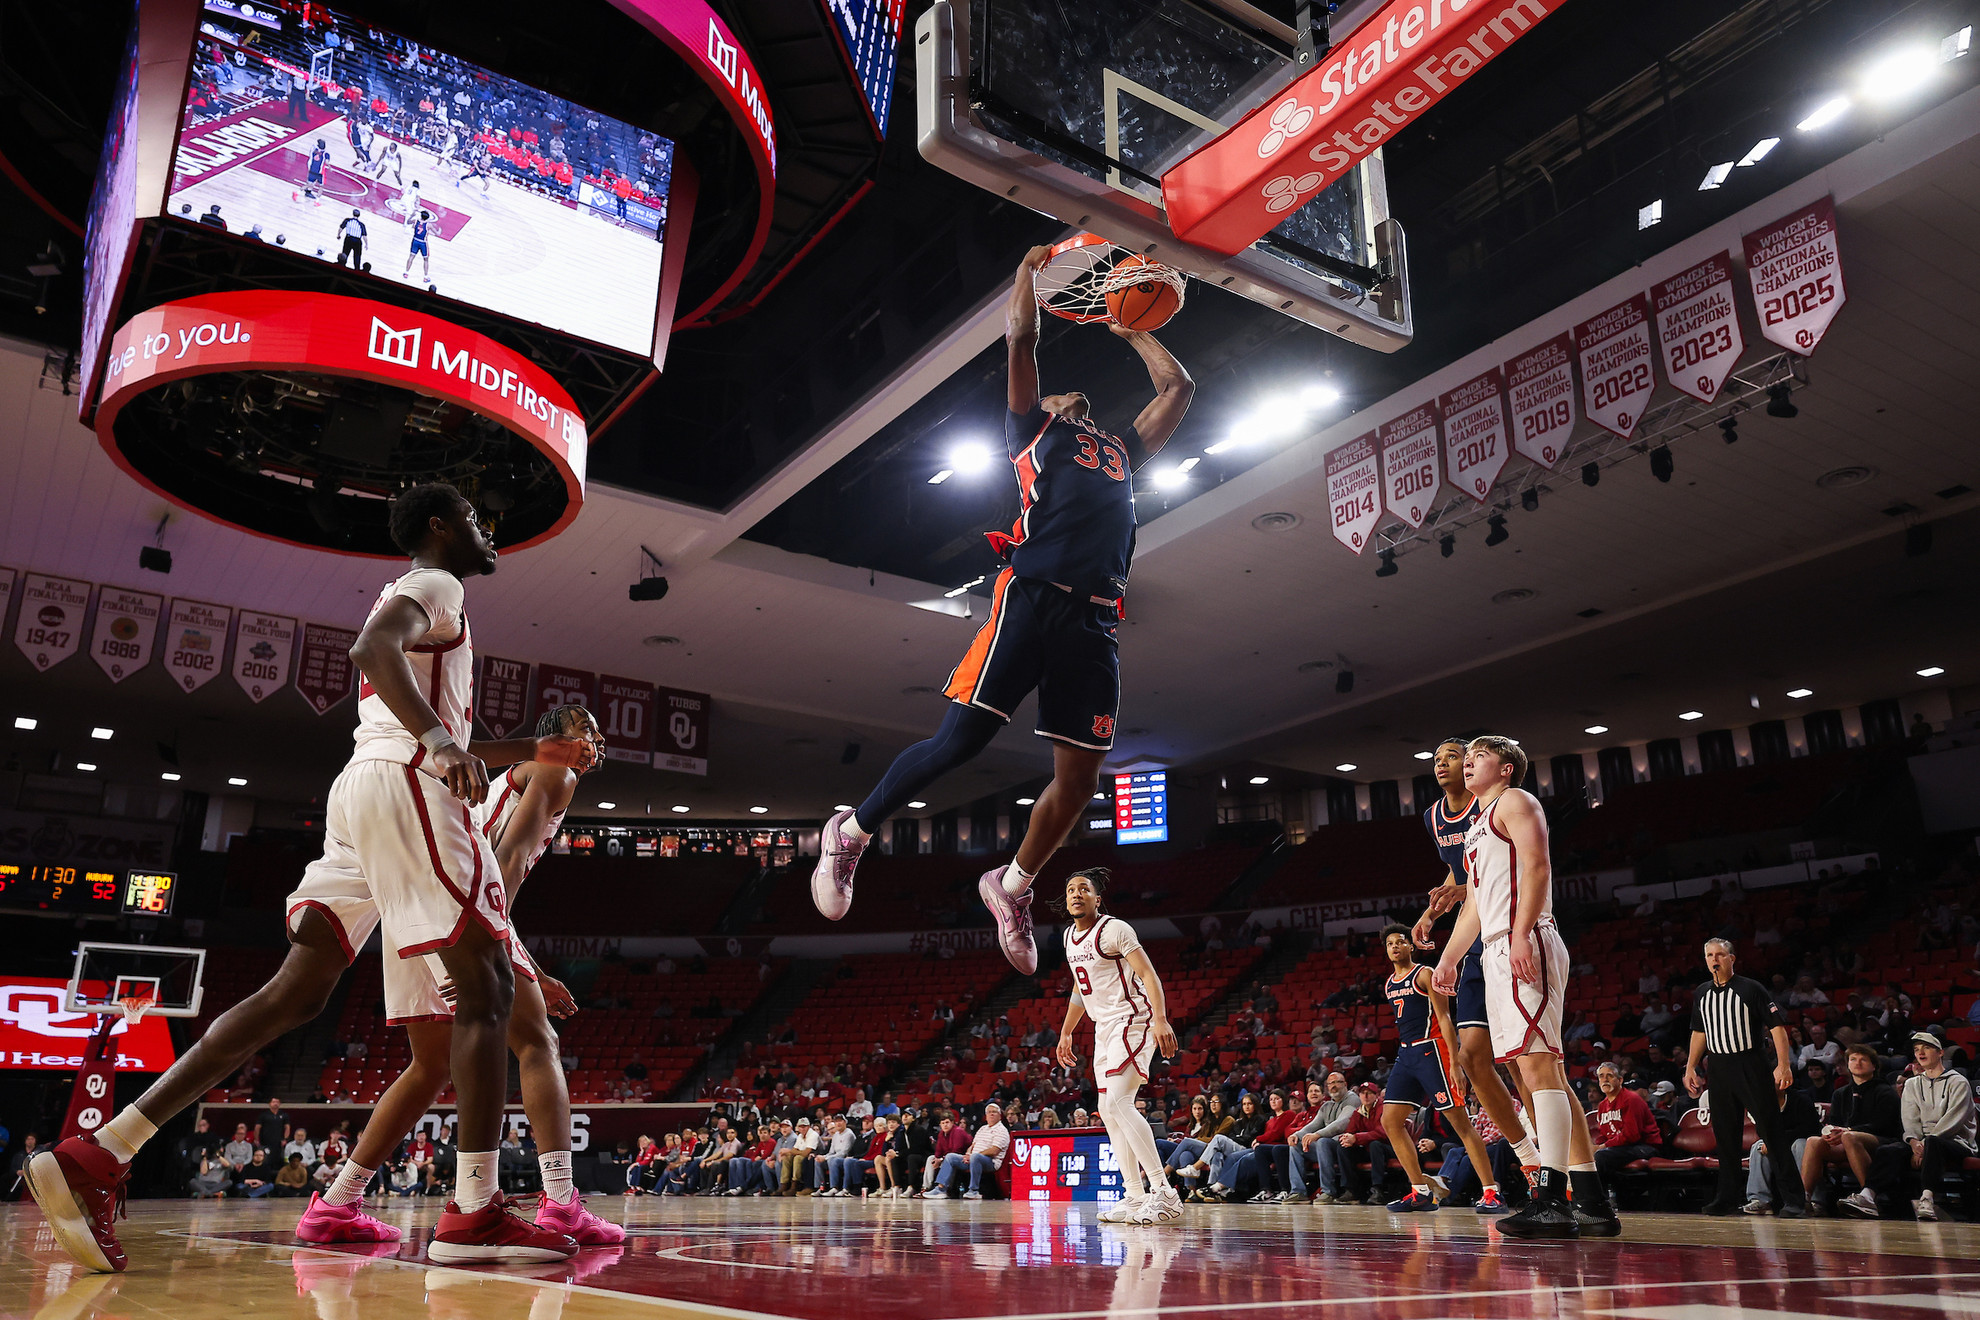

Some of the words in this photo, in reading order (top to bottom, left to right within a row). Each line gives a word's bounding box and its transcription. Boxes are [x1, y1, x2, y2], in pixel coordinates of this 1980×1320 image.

[1319, 0, 1473, 115] StateF
[1309, 0, 1548, 172] StateFarm
[1752, 220, 1828, 266] GYMNASTICS
[1760, 213, 1816, 248] WOMEN'S
[1756, 252, 1834, 294] CHAMPIONS
[1760, 241, 1826, 280] NATIONAL
[1658, 268, 1726, 309] GYMNASTICS
[1665, 261, 1714, 293] WOMEN'S
[1666, 292, 1726, 328] NATIONAL
[1764, 273, 1834, 327] 2025
[1580, 309, 1642, 348] GYMNASTICS
[1587, 303, 1632, 332] WOMEN'S
[1663, 303, 1731, 344] CHAMPIONS
[106, 346, 136, 382] rue
[143, 333, 170, 360] to
[174, 322, 251, 360] you.
[1586, 343, 1649, 382] CHAMPIONS
[1587, 332, 1642, 367] NATIONAL
[1671, 324, 1732, 374] 2023
[1515, 380, 1571, 415] CHAMPIONS
[1516, 370, 1566, 401] NATIONAL
[1593, 363, 1650, 410] 2022
[1450, 405, 1496, 433] NATIONAL
[1450, 414, 1500, 448] CHAMPIONS
[1523, 400, 1570, 441] 2019
[1074, 434, 1125, 482] 33
[1388, 446, 1436, 476] CHAMPIONS
[1389, 436, 1431, 463] NATIONAL
[1458, 433, 1496, 472] 2017
[1330, 474, 1376, 502] CHAMPIONS
[1332, 465, 1372, 490] NATIONAL
[1394, 464, 1433, 500] 2016
[1335, 490, 1374, 528] 2014
[27, 588, 57, 600] FINAL
[60, 594, 86, 604] FOUR
[26, 628, 70, 648] 1947
[101, 640, 140, 660] 1988
[307, 636, 350, 649] CHAMPION
[172, 651, 214, 671] 2002
[242, 662, 278, 681] 2016
[491, 660, 521, 680] NIT
[554, 674, 580, 688] KING
[604, 684, 650, 700] BLAYLOCK
[668, 696, 701, 710] TUBBS
[606, 699, 643, 738] 10
[670, 712, 696, 749] OU
[1438, 832, 1467, 848] AUBU
[52, 887, 62, 899] 2
[93, 883, 116, 900] 52
[909, 932, 1001, 953] #SOONE
[1076, 966, 1092, 996] 9
[1394, 998, 1404, 1018] 7
[12, 1051, 144, 1068] Heah
[86, 1074, 107, 1098] OU
[1697, 1108, 1710, 1126] OU
[1030, 1145, 1050, 1172] 66
[1098, 1144, 1119, 1172] 52
[1062, 1156, 1085, 1170] 11:30
